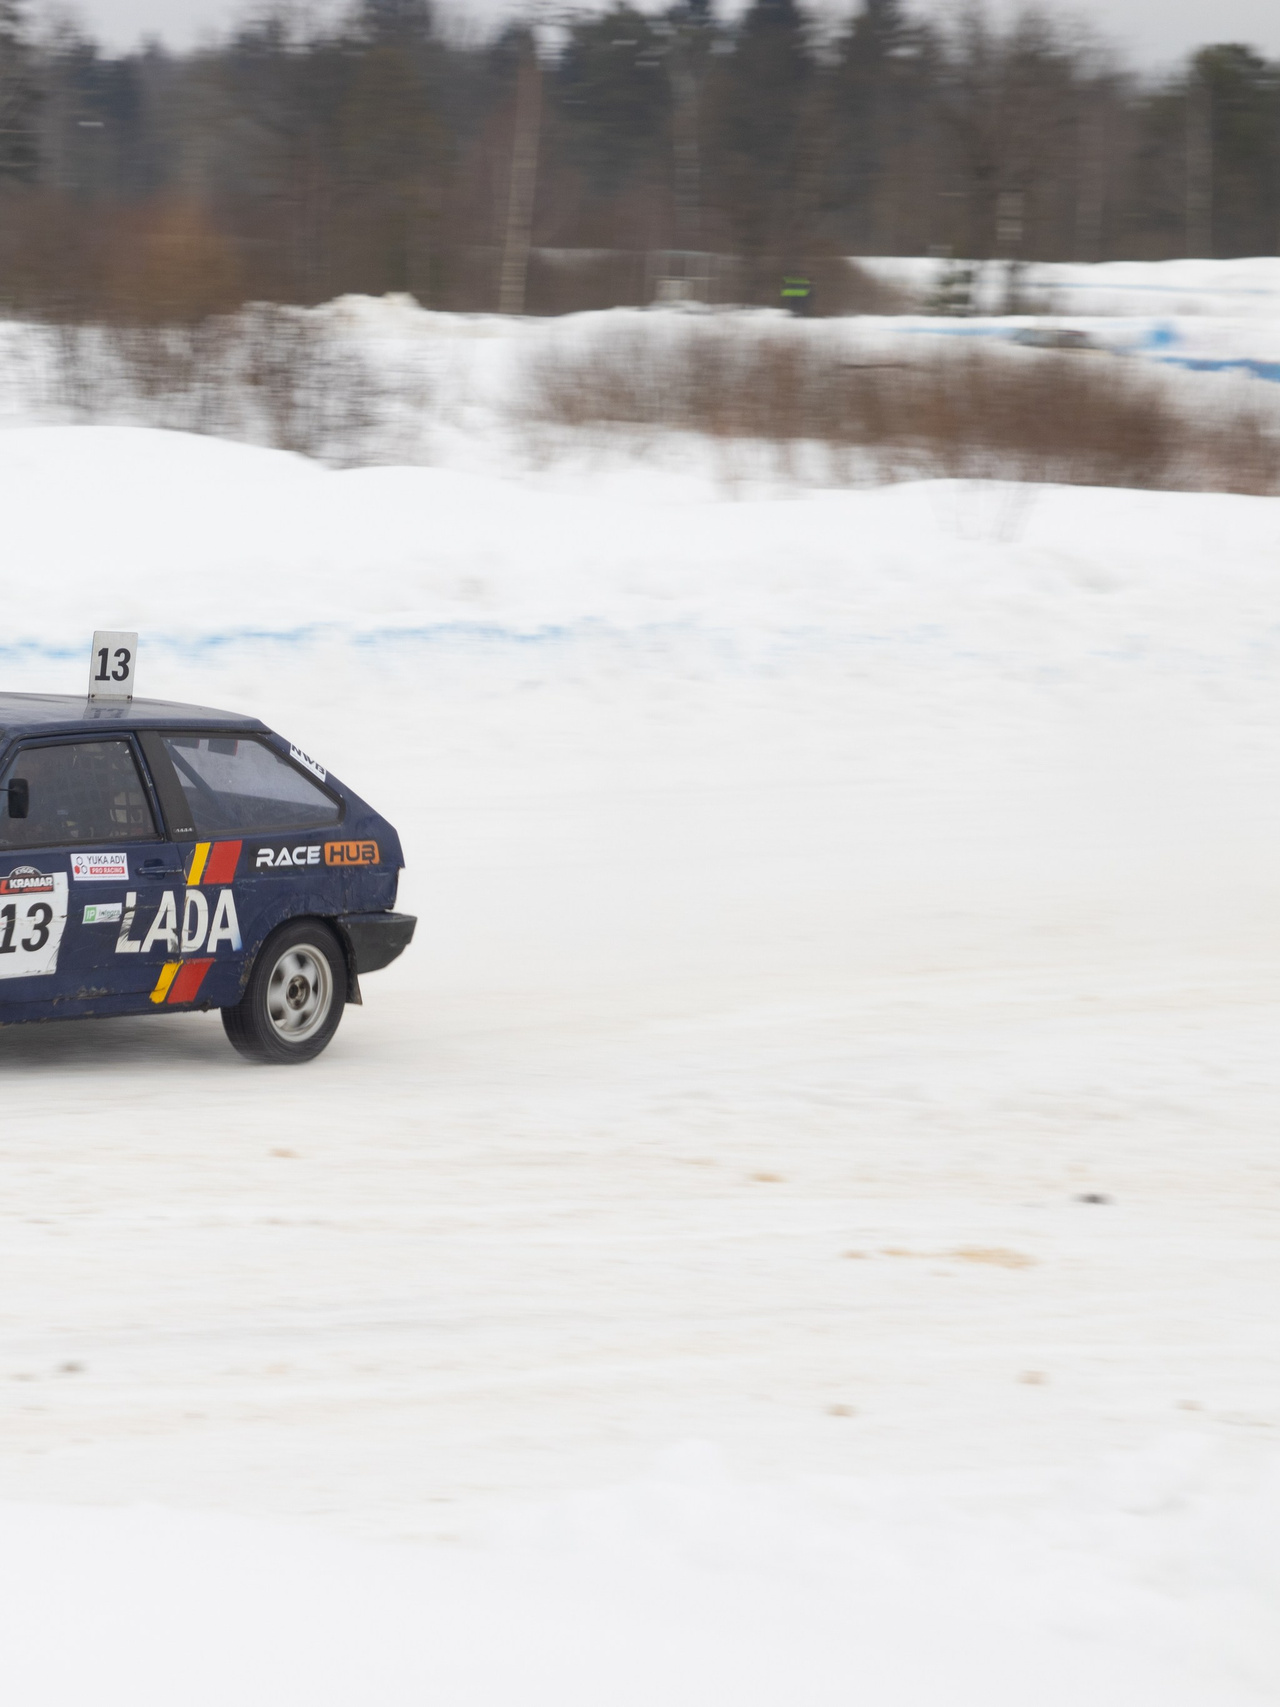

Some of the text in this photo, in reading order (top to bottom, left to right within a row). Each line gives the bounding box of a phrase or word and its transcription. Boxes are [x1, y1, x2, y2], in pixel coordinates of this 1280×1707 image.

[94, 647, 131, 682] 13
[292, 744, 326, 775] NWB
[86, 855, 125, 865] YUKA ADV
[256, 844, 376, 867] RACE HUB
[104, 866, 123, 874] RACING
[10, 876, 53, 889] KRAMAR
[115, 889, 243, 953] LADA
